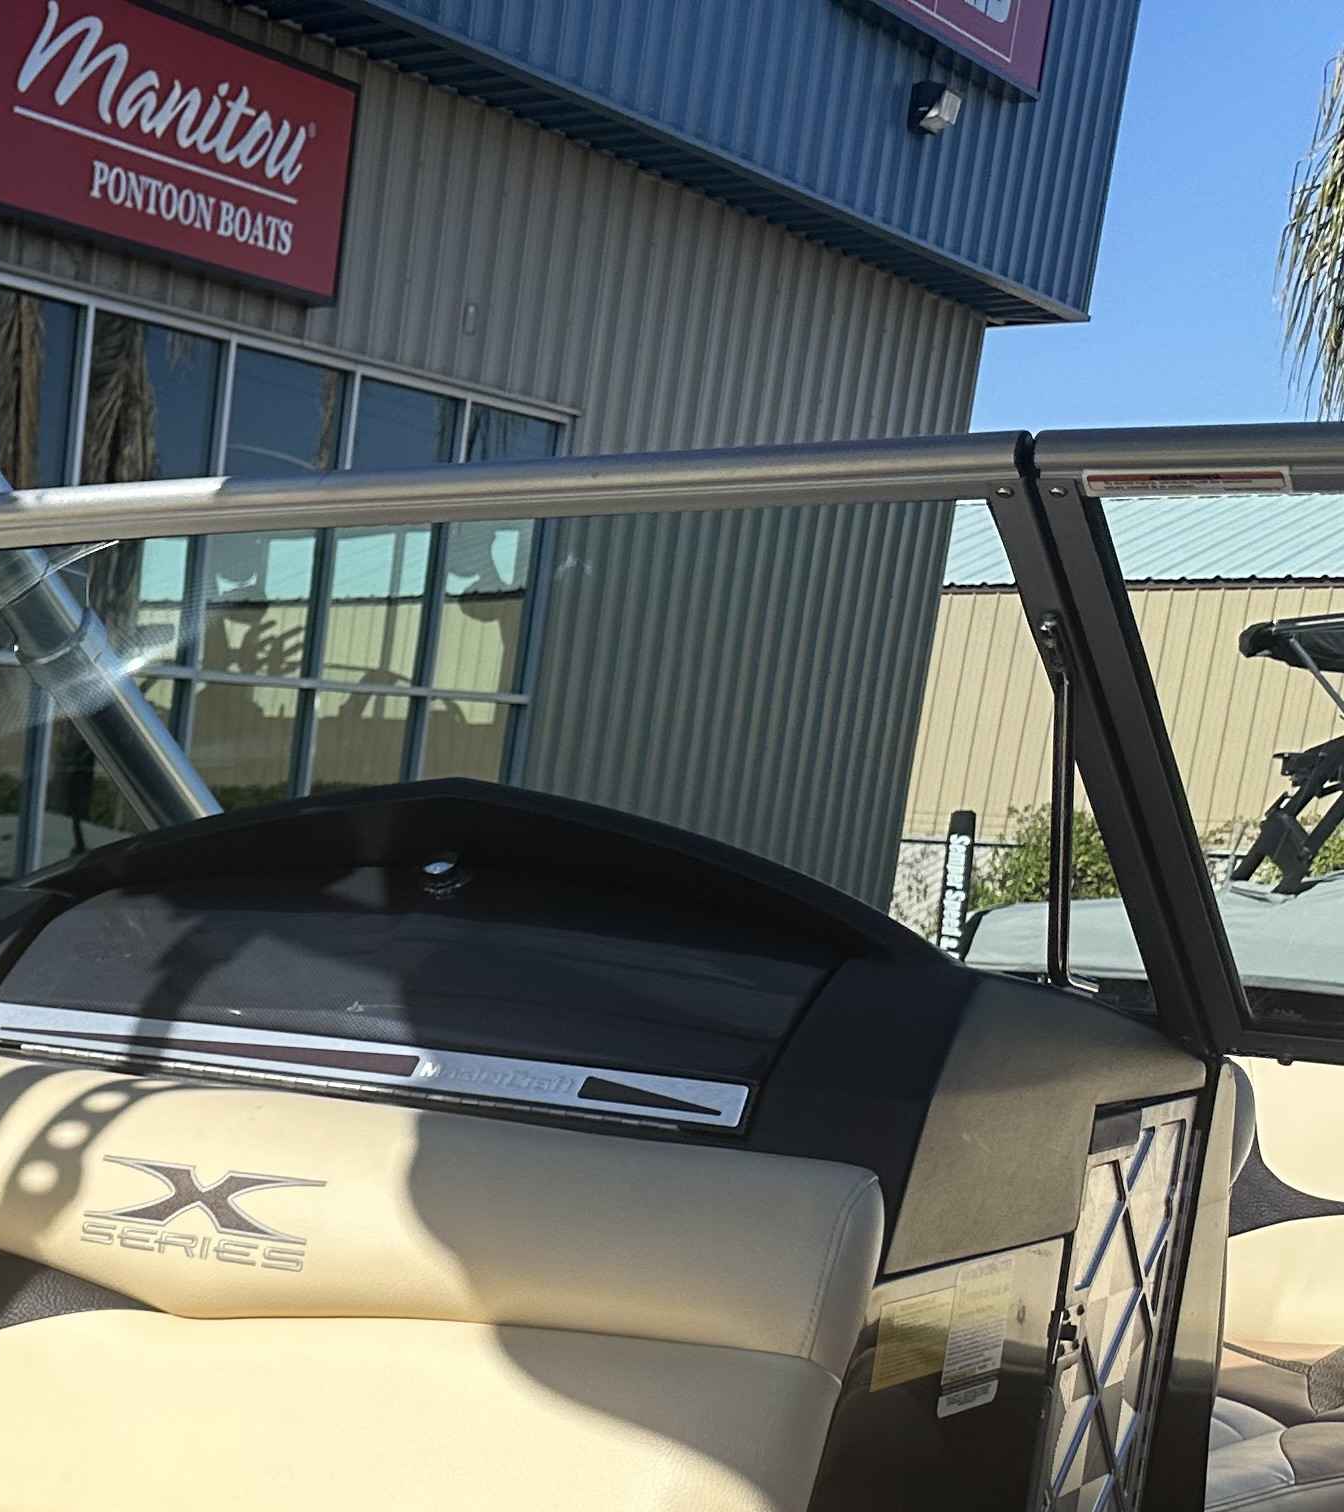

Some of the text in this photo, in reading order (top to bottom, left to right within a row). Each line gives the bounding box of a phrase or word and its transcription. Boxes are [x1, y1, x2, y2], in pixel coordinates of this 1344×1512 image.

[18, 0, 308, 186] Manitou
[90, 160, 295, 256] PONTOON BOATS
[945, 833, 971, 890] Semper
[942, 888, 966, 938] Speed
[83, 1154, 328, 1246] X
[80, 1220, 306, 1273] SERIES
